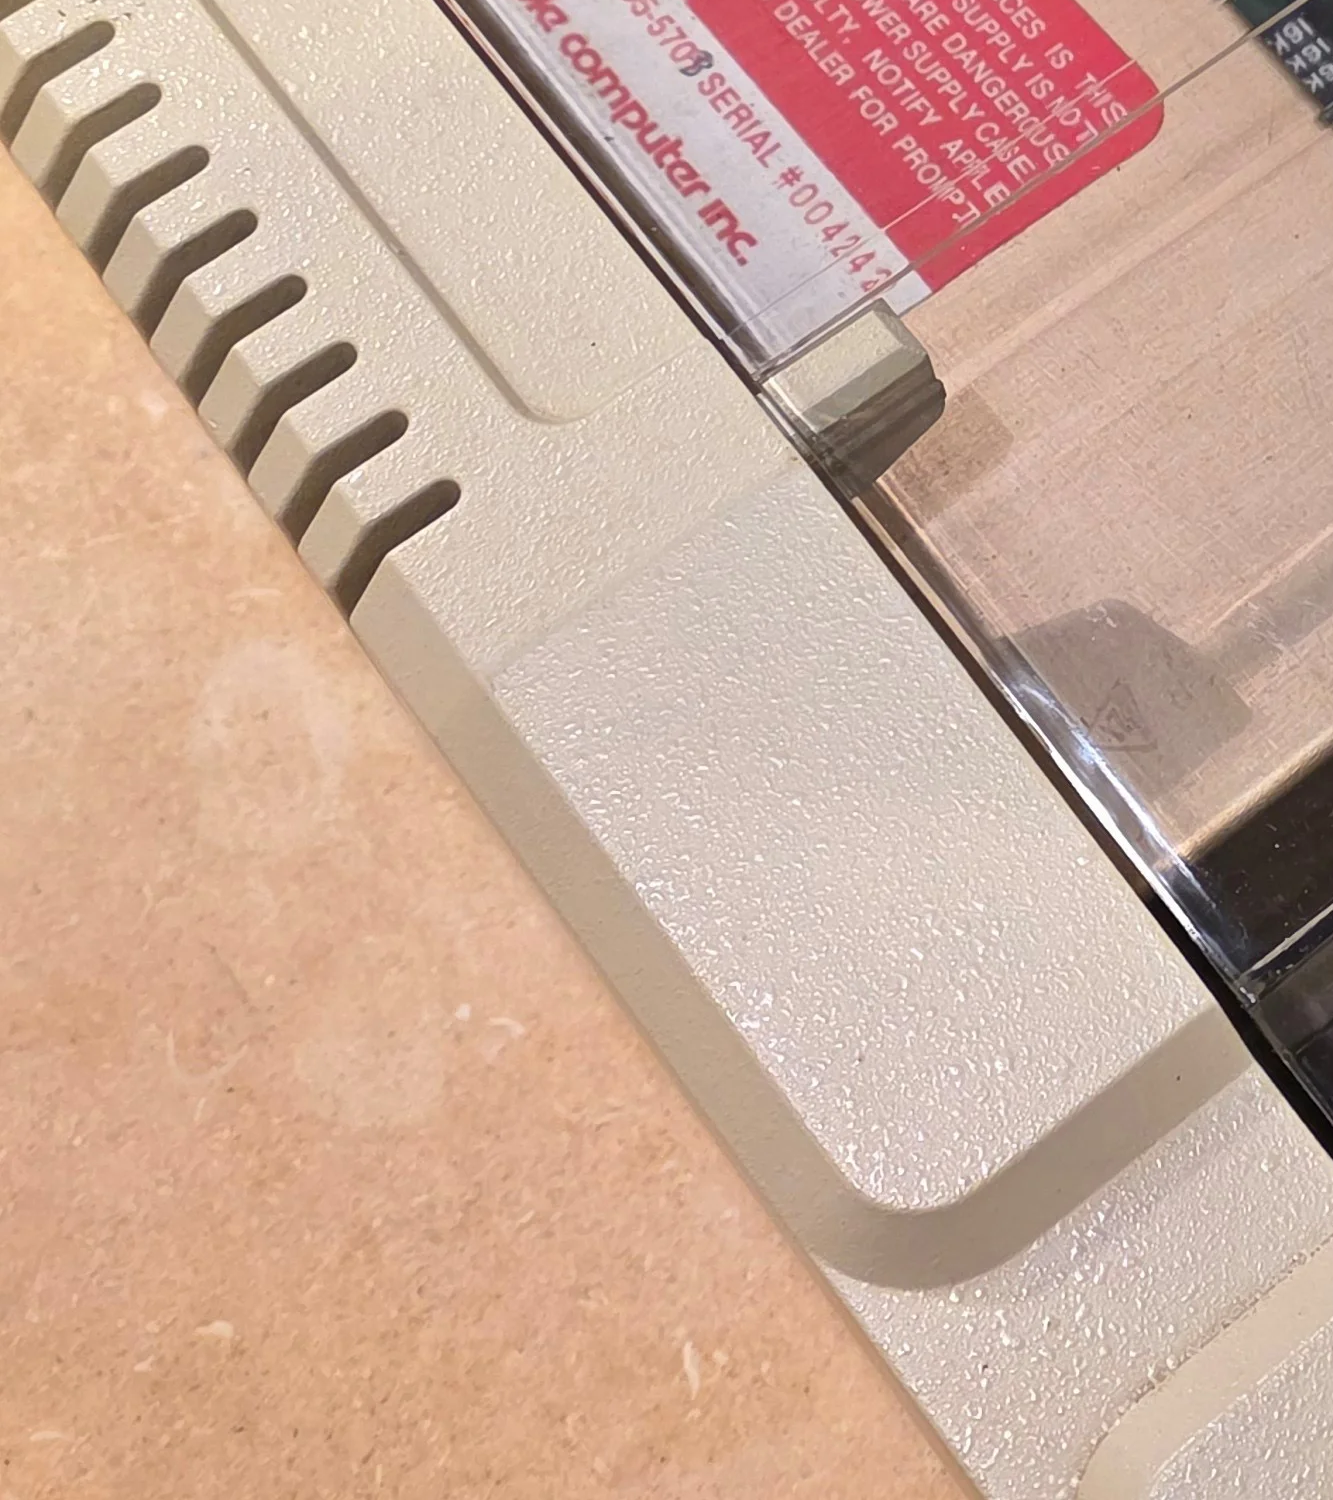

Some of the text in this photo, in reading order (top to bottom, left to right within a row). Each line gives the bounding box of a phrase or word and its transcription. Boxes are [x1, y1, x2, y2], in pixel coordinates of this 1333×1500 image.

[694, 70, 790, 166] SERIAL
[772, 1, 853, 84] DEALER
[847, 86, 897, 135] FOR
[902, 41, 982, 122] SUPPLY
[941, 34, 1067, 164] DANGEROUS
[1025, 73, 1054, 97] IS
[1047, 97, 1096, 143] NOT
[1043, 43, 1073, 68] IS
[1071, 74, 1126, 125] THIS
[558, 30, 711, 204] computer
[699, 198, 758, 267] inc.
[861, 50, 938, 128] NOTIFY
[940, 137, 1008, 205] APPLE
